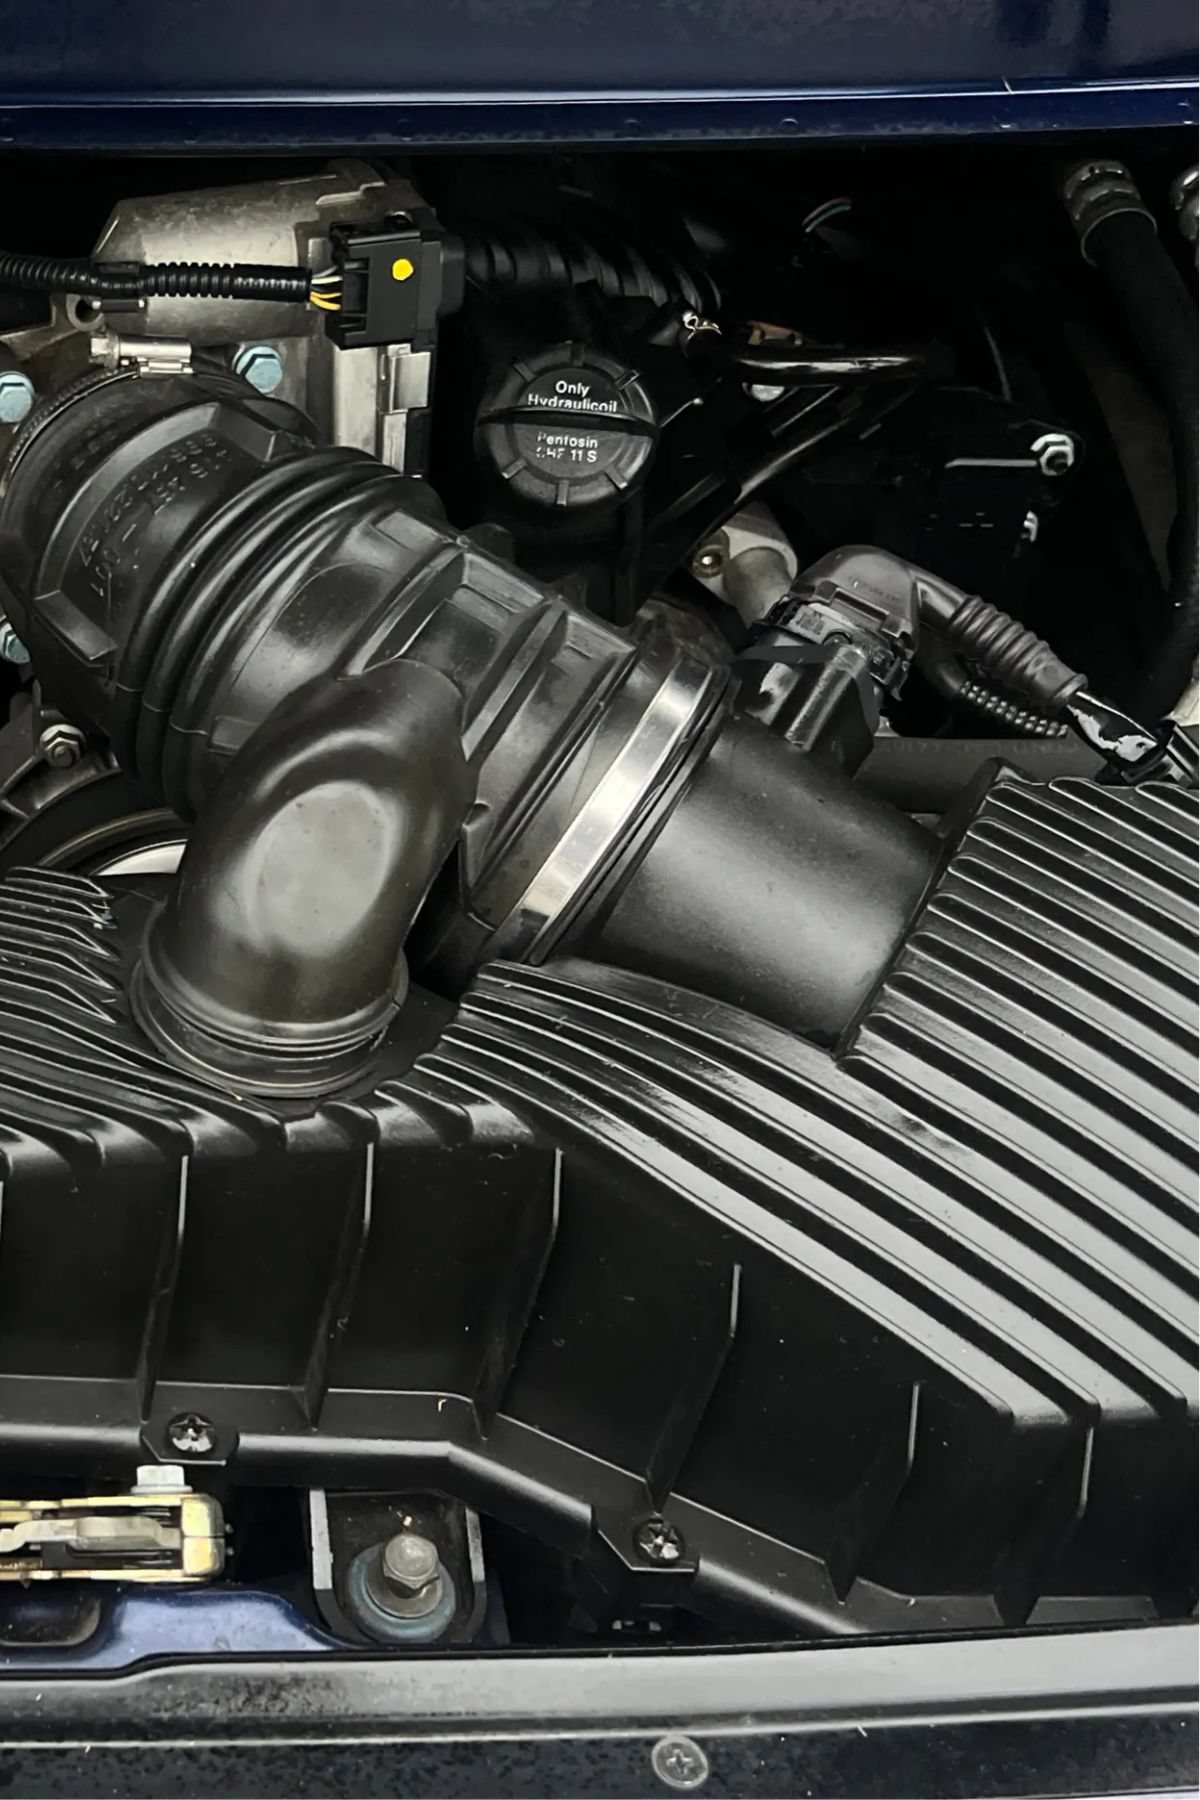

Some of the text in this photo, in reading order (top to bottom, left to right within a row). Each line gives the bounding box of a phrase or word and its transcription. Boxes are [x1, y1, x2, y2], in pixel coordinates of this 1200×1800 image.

[555, 380, 590, 398] Only
[527, 393, 618, 412] Hydraulicoil
[570, 449, 583, 461] 11
[586, 450, 597, 463] S
